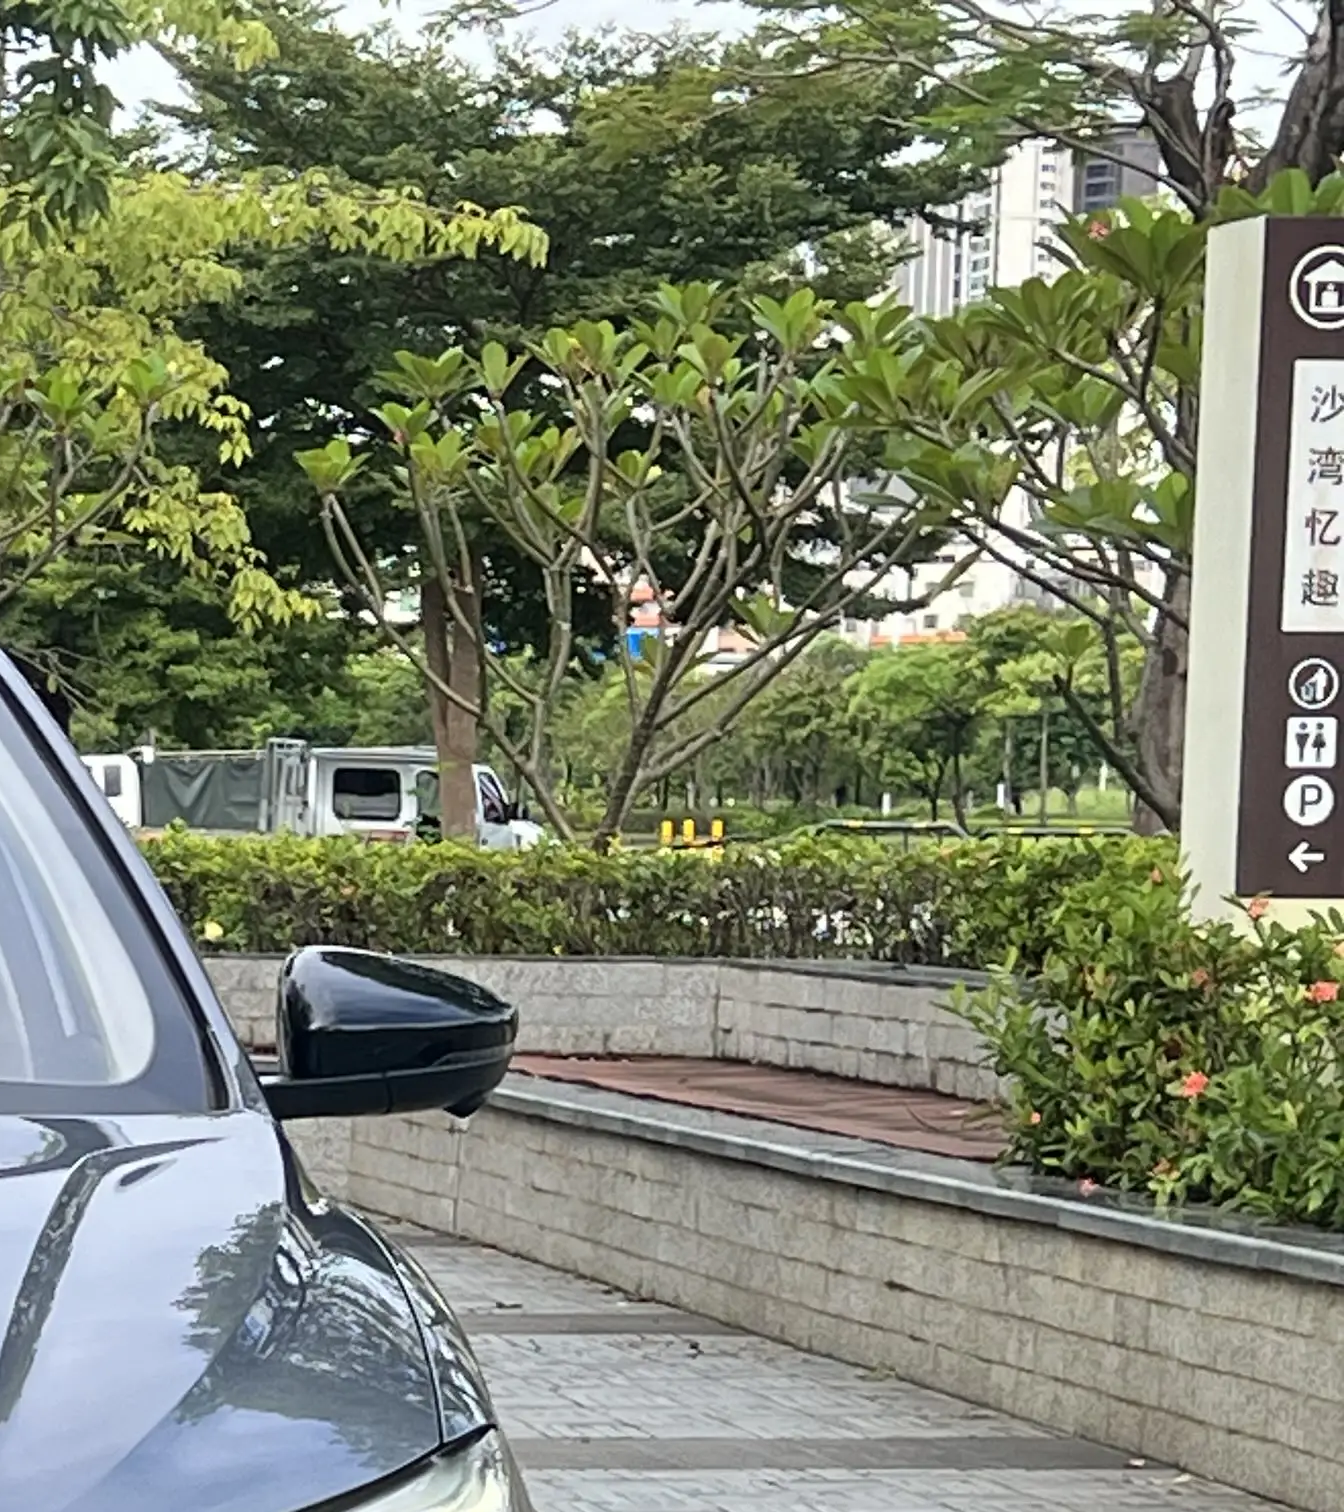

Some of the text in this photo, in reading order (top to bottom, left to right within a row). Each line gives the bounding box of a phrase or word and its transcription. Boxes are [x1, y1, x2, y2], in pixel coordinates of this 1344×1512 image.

[1301, 385, 1344, 606] 沙湾忆趣
[1299, 784, 1323, 817] P
